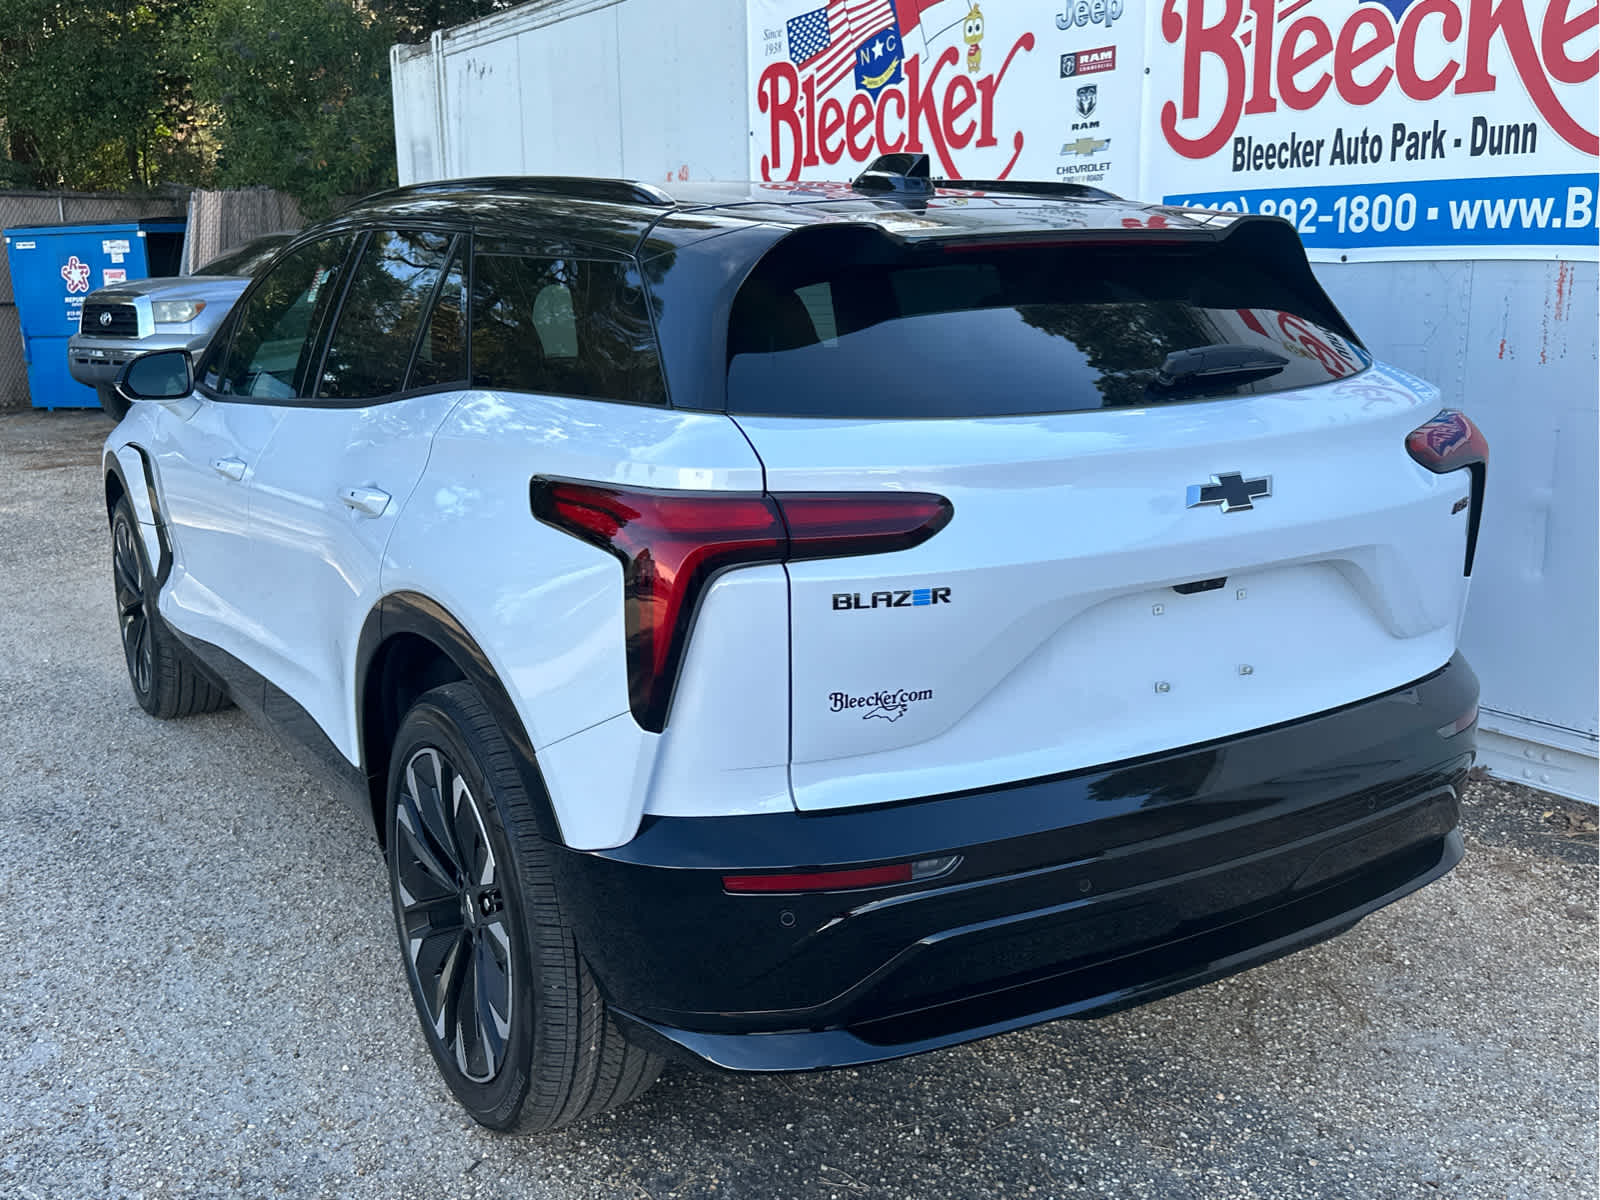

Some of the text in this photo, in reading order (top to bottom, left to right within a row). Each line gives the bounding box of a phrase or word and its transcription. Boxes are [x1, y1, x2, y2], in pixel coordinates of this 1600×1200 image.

[1056, 0, 1123, 30] Jeep
[1079, 50, 1113, 64] RAM
[1071, 120, 1100, 131] RAM
[1232, 116, 1537, 172] Bleecker Auto Park Dunn
[1056, 161, 1112, 175] CHEVROLET
[832, 587, 952, 611] BLAZER
